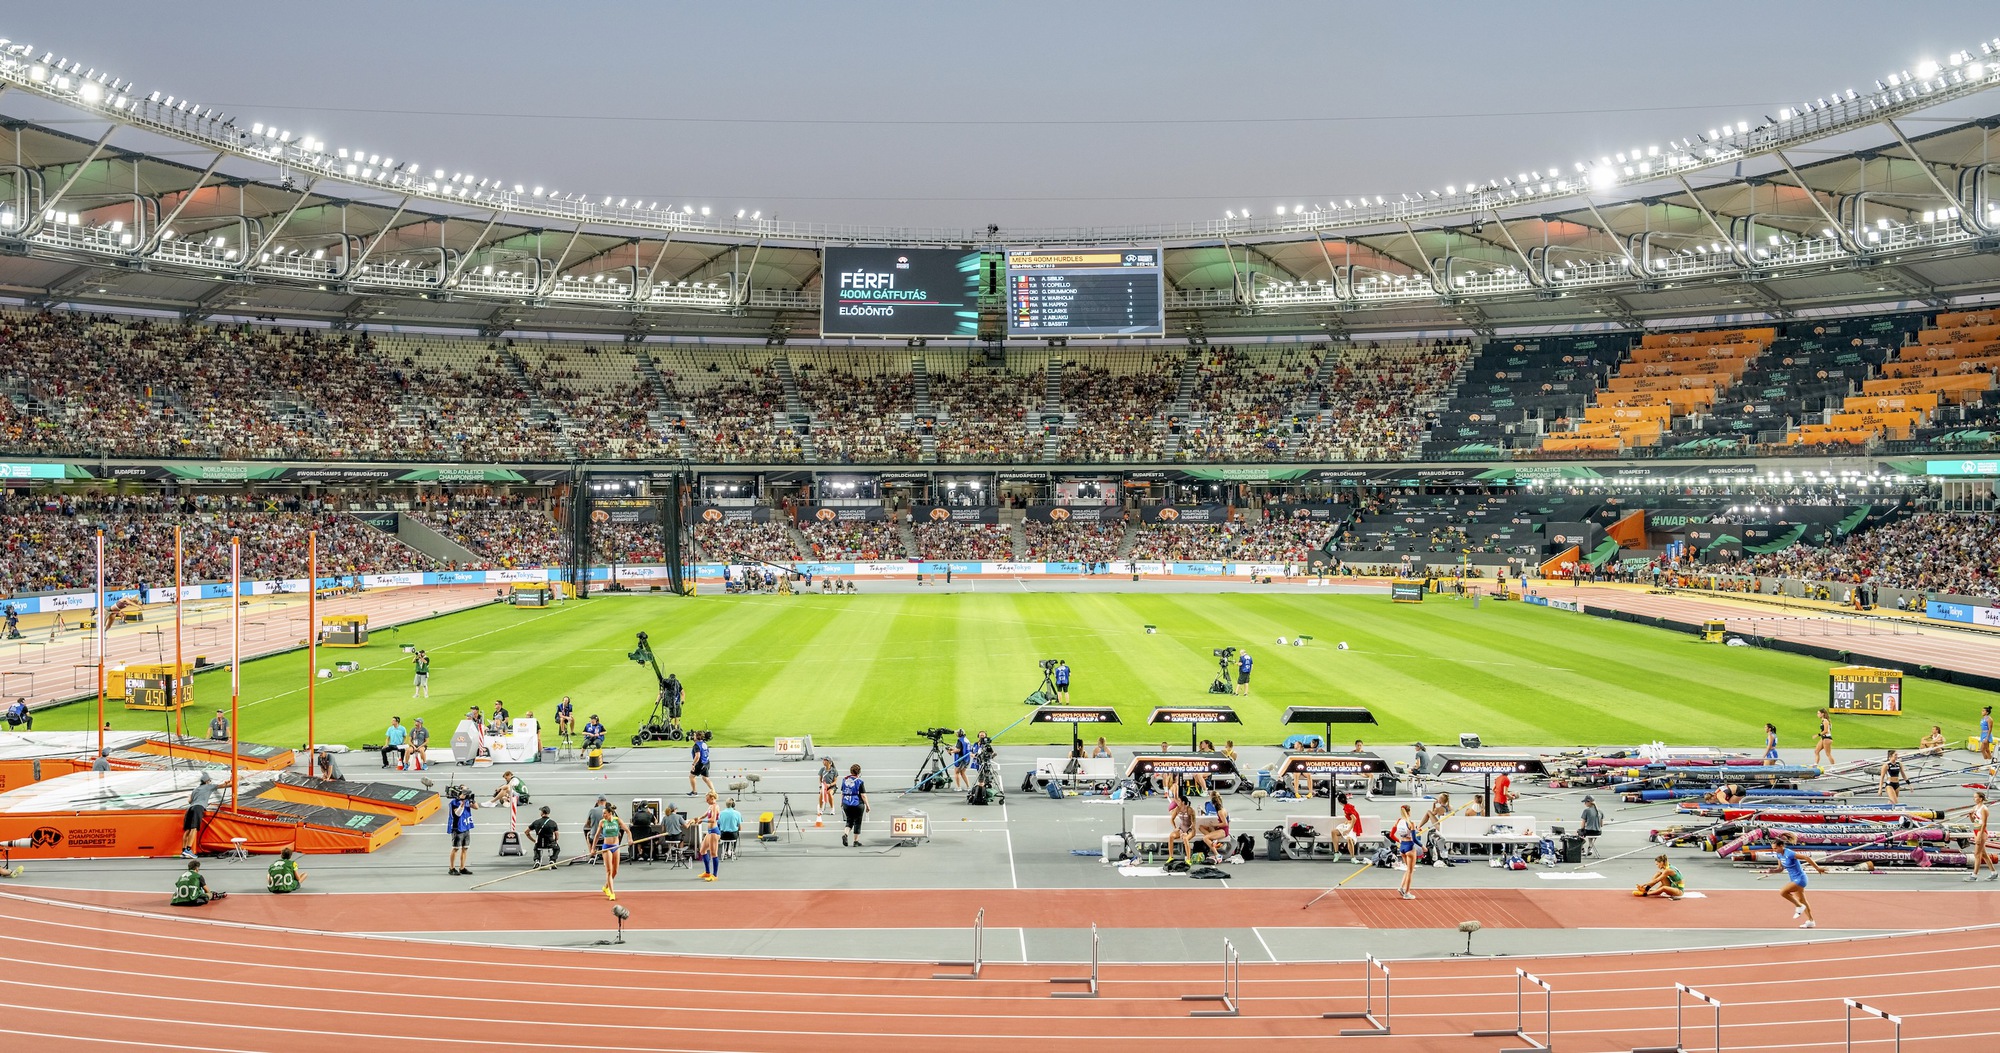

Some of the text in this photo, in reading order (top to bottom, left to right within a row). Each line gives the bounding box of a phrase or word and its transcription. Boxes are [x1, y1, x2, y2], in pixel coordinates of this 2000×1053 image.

[841, 269, 894, 289] FÉRFI
[840, 288, 927, 300] 400M GÁTFUTÁS
[839, 305, 894, 316] ELŐDÖNTŐ
[1834, 682, 1854, 691] HOLM
[146, 690, 165, 706] 4.50
[1865, 694, 1882, 709] 15
[895, 823, 907, 832] 60
[1861, 852, 1910, 860] NDERSSON
